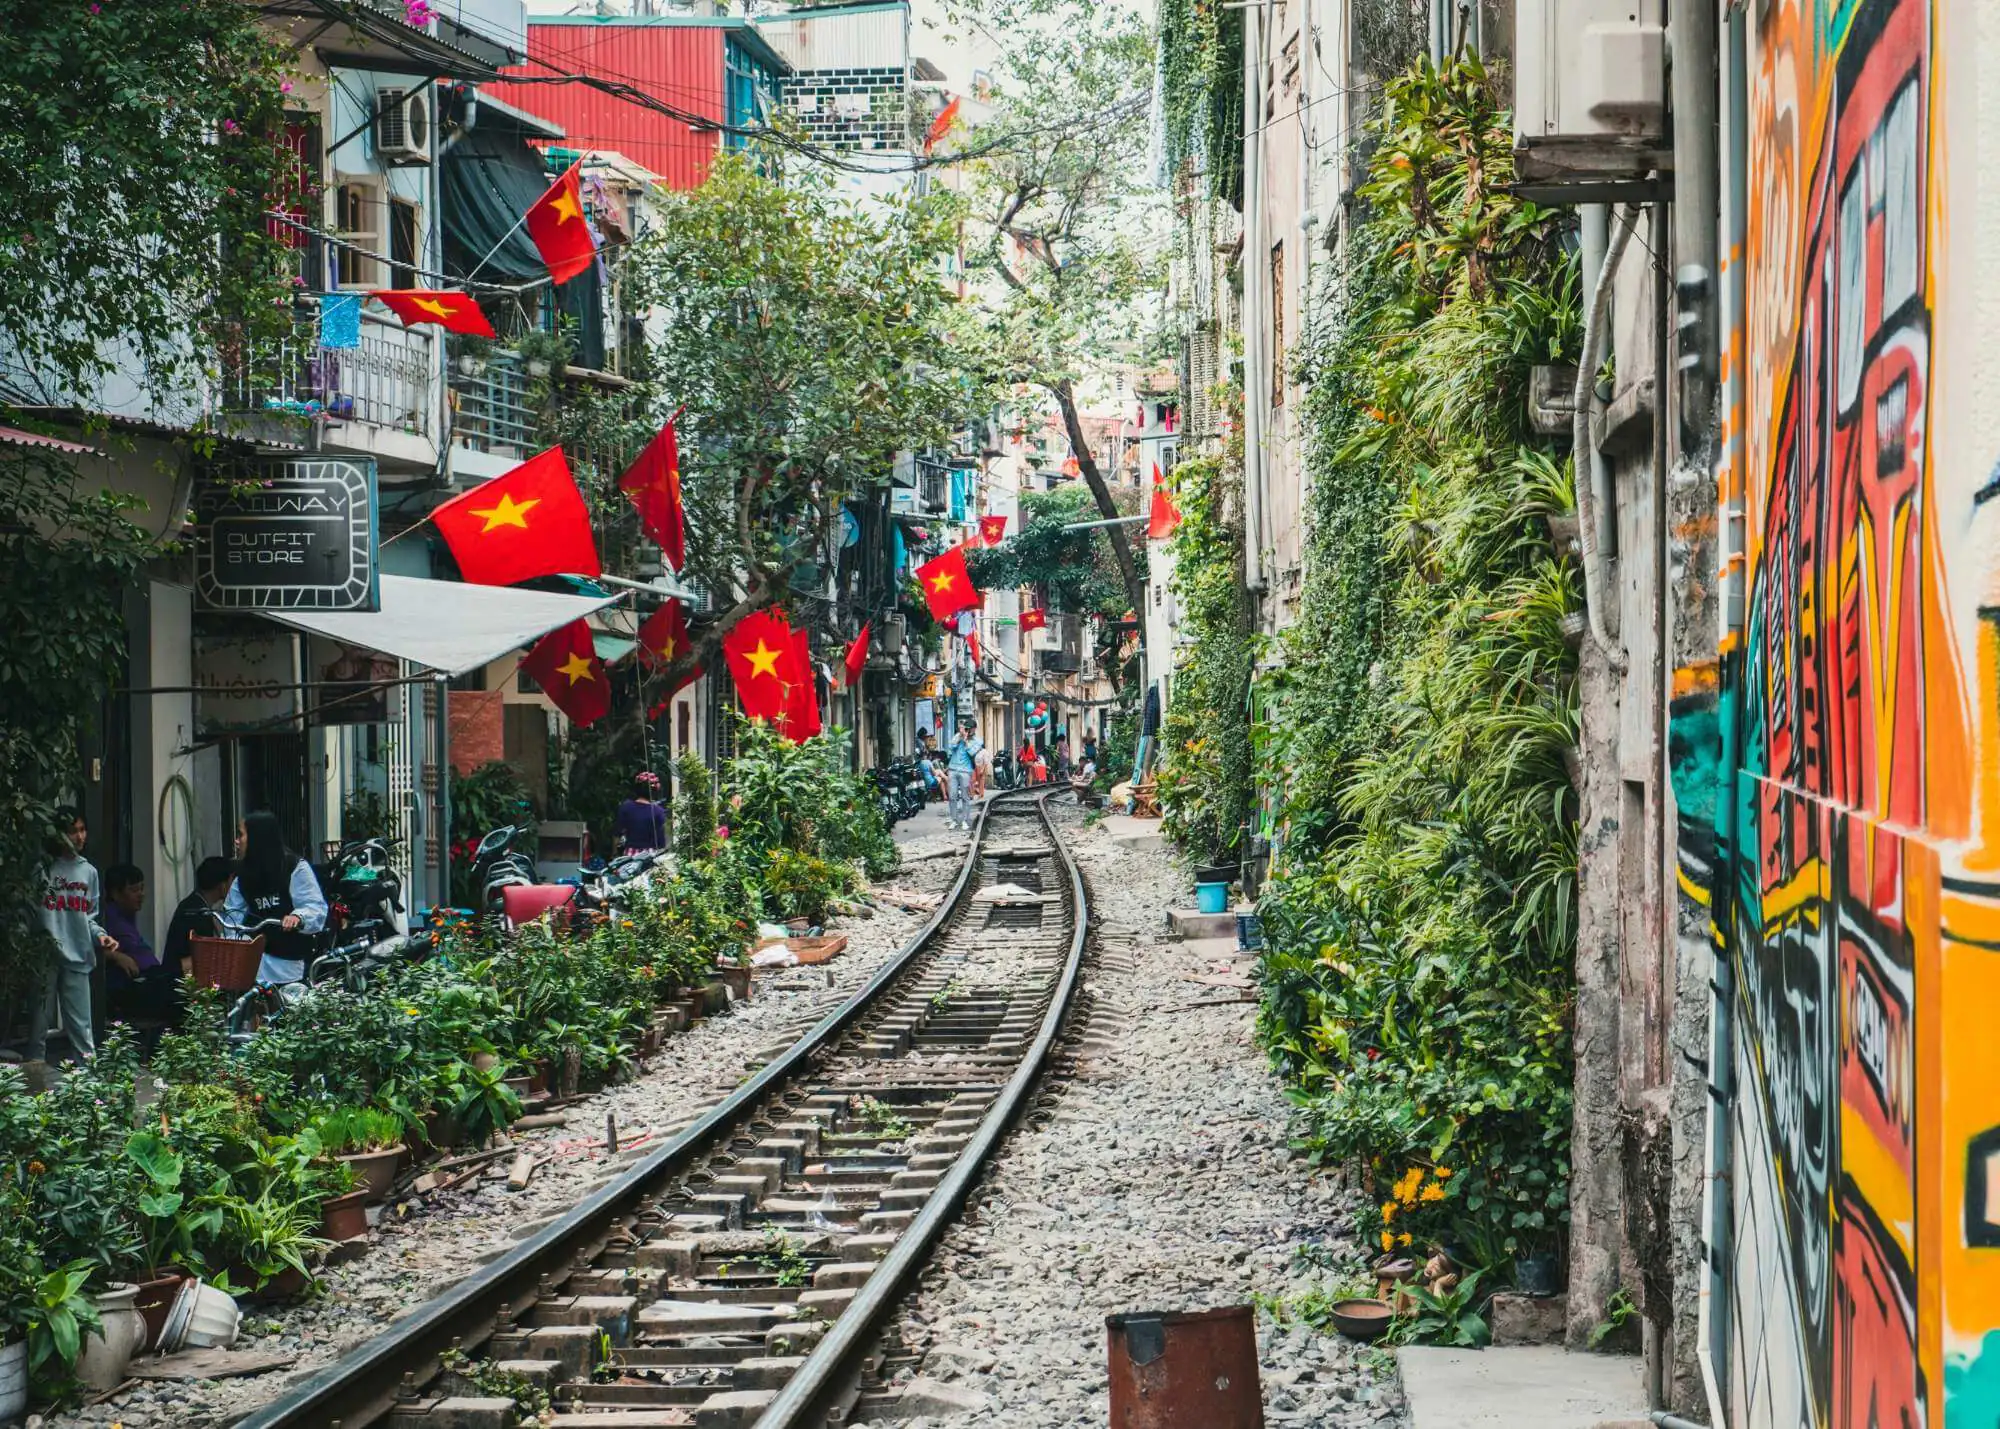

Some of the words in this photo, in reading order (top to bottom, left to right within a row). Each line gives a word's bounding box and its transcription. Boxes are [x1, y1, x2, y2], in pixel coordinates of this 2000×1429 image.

[200, 496, 347, 512] RAILWAY
[227, 532, 316, 546] OUTFIT
[227, 550, 304, 563] STORE
